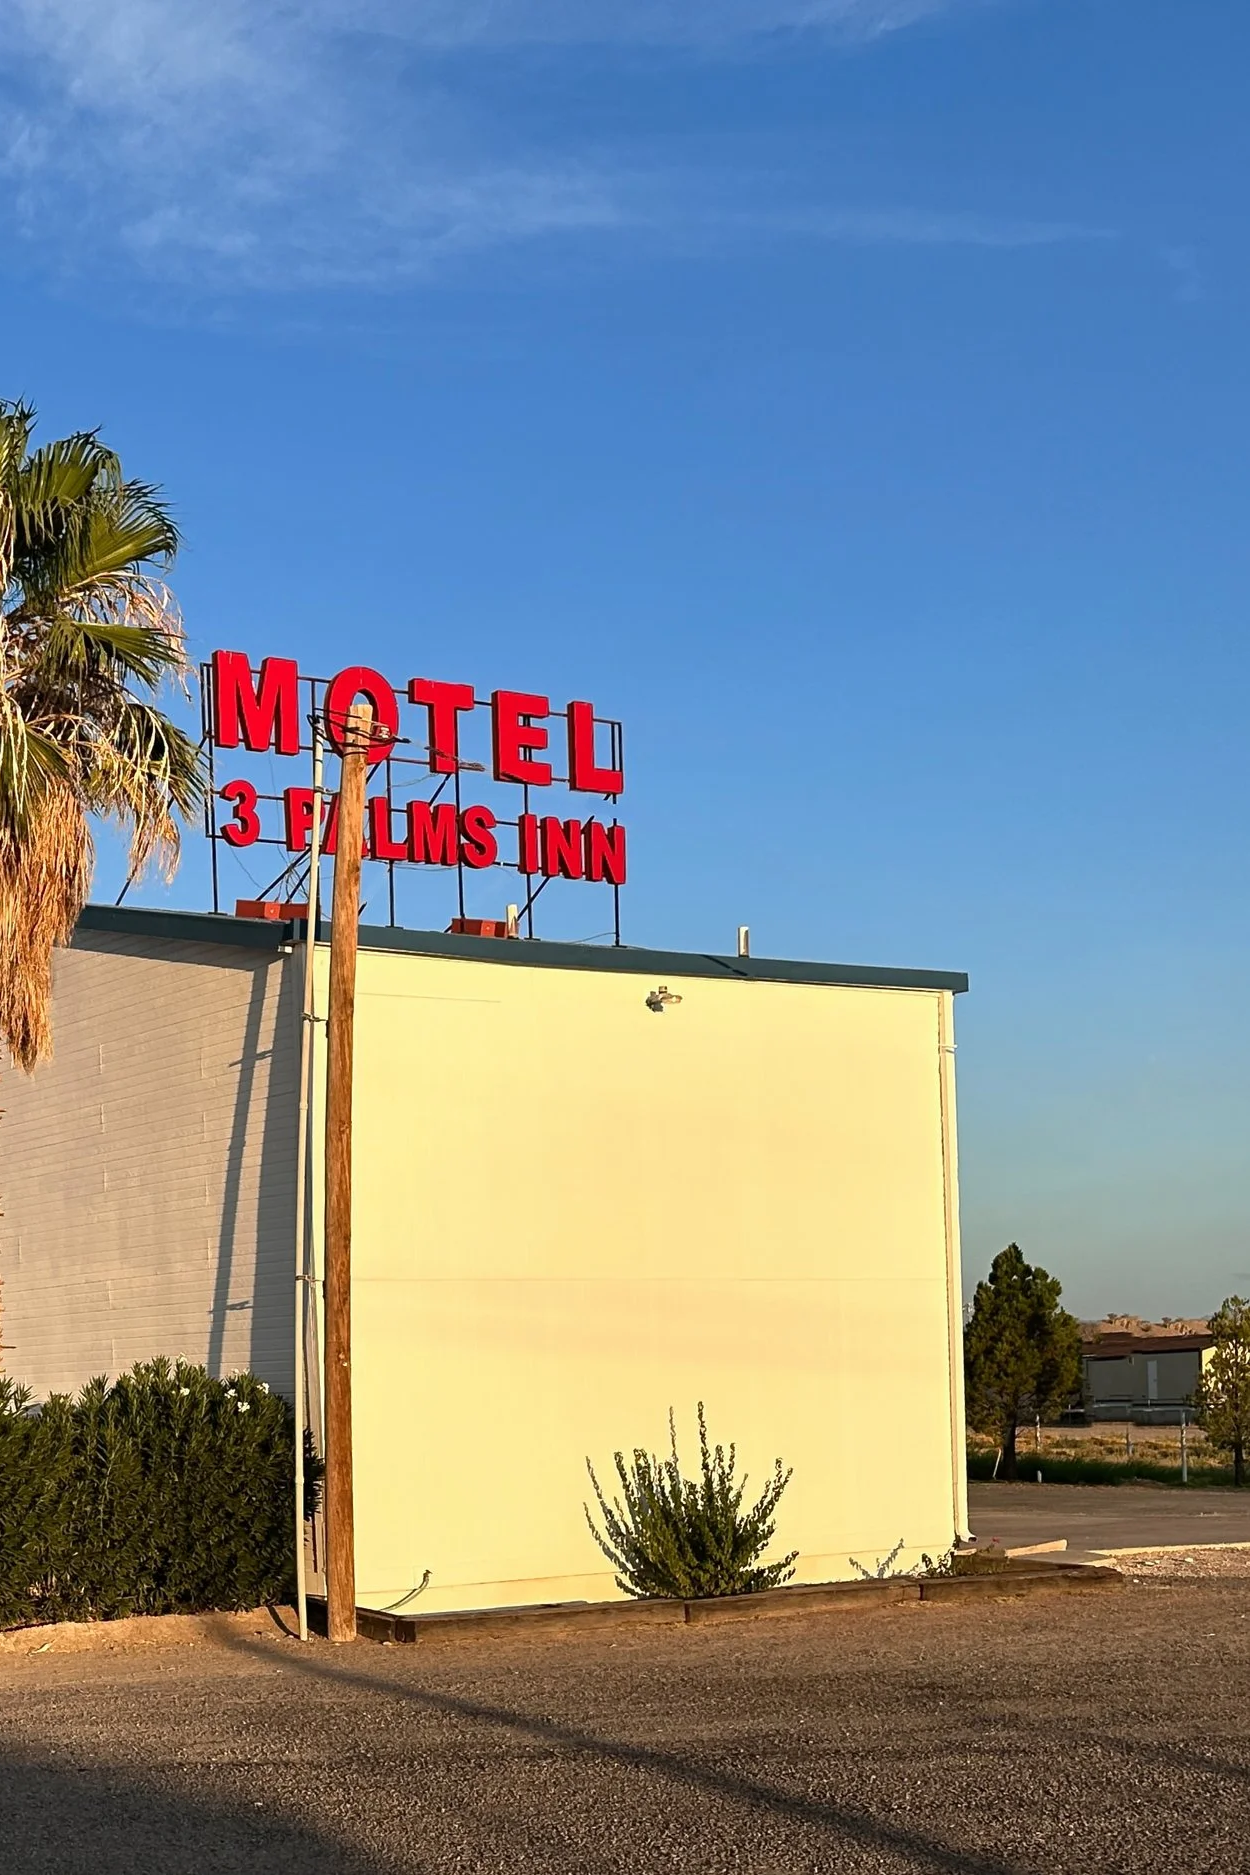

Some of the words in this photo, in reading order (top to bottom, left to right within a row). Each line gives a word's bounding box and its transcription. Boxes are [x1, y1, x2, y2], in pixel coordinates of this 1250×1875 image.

[212, 649, 624, 794] MOTEL
[220, 779, 260, 847] 3
[518, 813, 626, 885] INN
